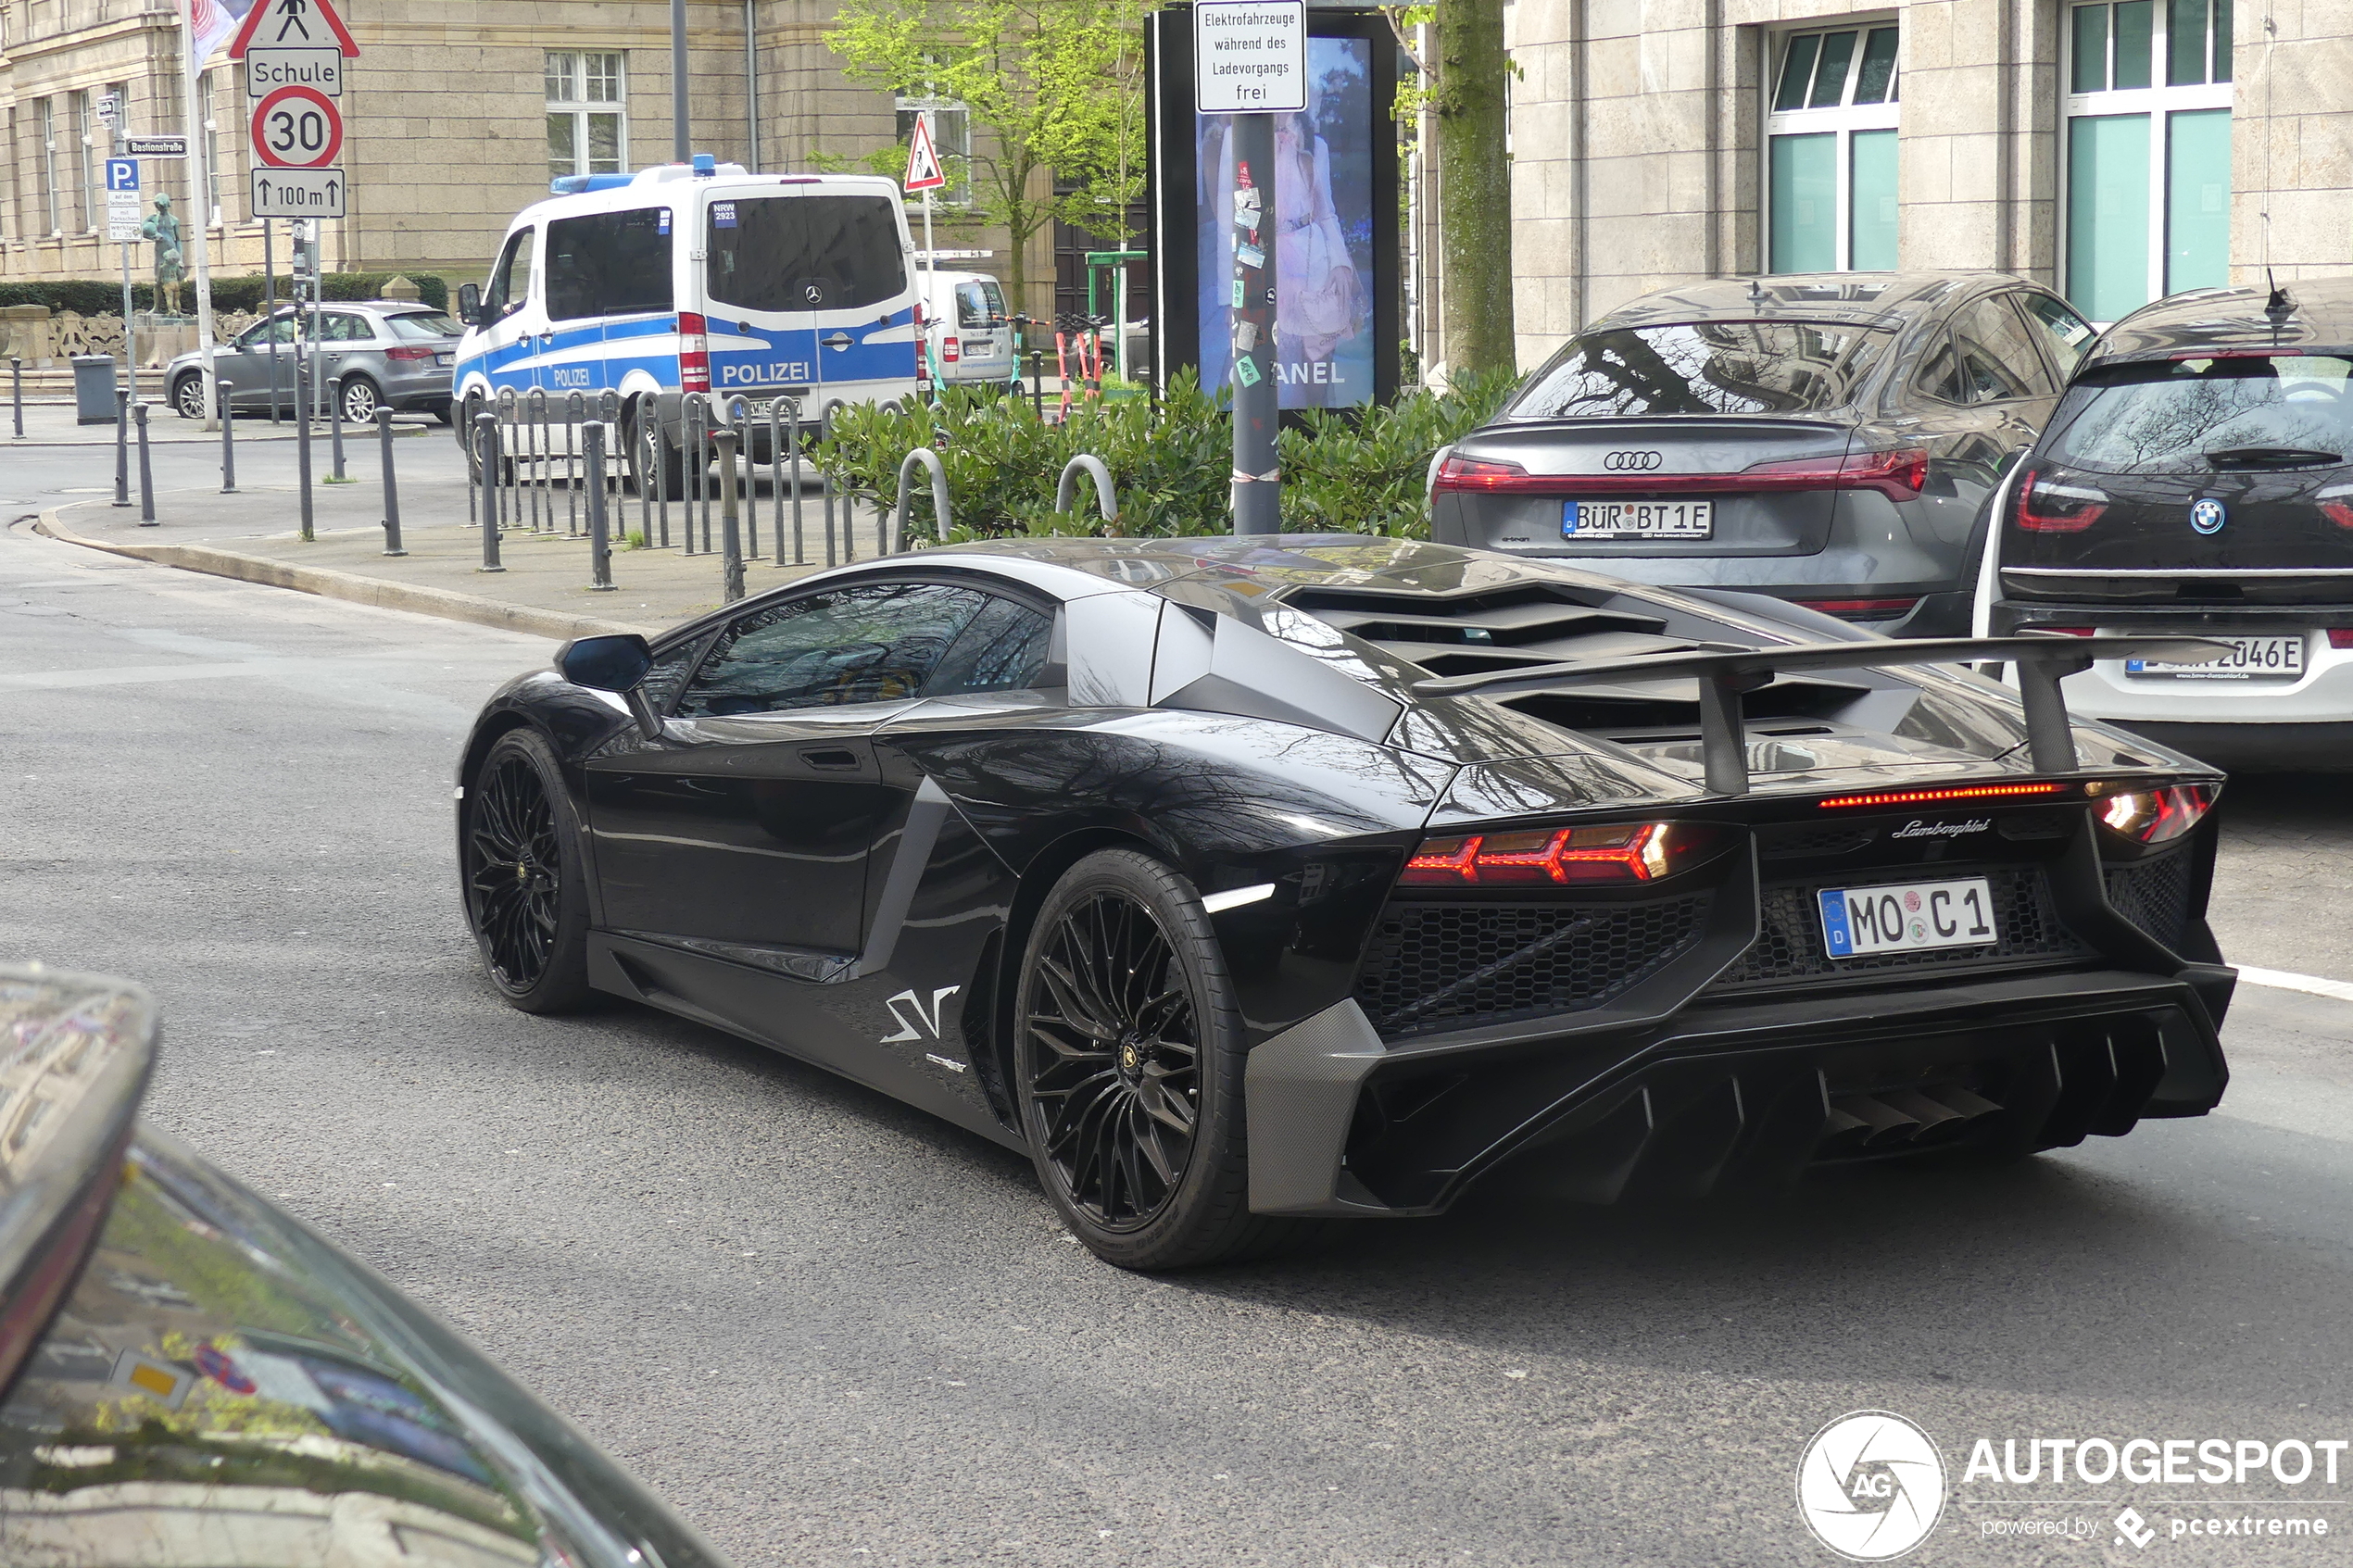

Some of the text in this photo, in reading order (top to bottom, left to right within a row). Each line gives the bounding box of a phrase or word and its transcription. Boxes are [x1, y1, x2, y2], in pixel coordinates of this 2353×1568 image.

[1205, 12, 1295, 28] Elektrofahrzeuge
[1214, 36, 1287, 50] während des
[255, 62, 334, 82] Schule
[1213, 62, 1290, 77] Ladevorgangs
[1237, 83, 1266, 100] frei
[271, 111, 323, 151] 30
[132, 142, 182, 152] Bastionstraße
[277, 186, 322, 205] 100 m
[713, 204, 736, 212] NRW
[554, 368, 590, 388] POLIZEI
[724, 362, 809, 384] POLIZEI
[1892, 819, 1991, 839] Lamborghini
[1849, 895, 1904, 946] MO
